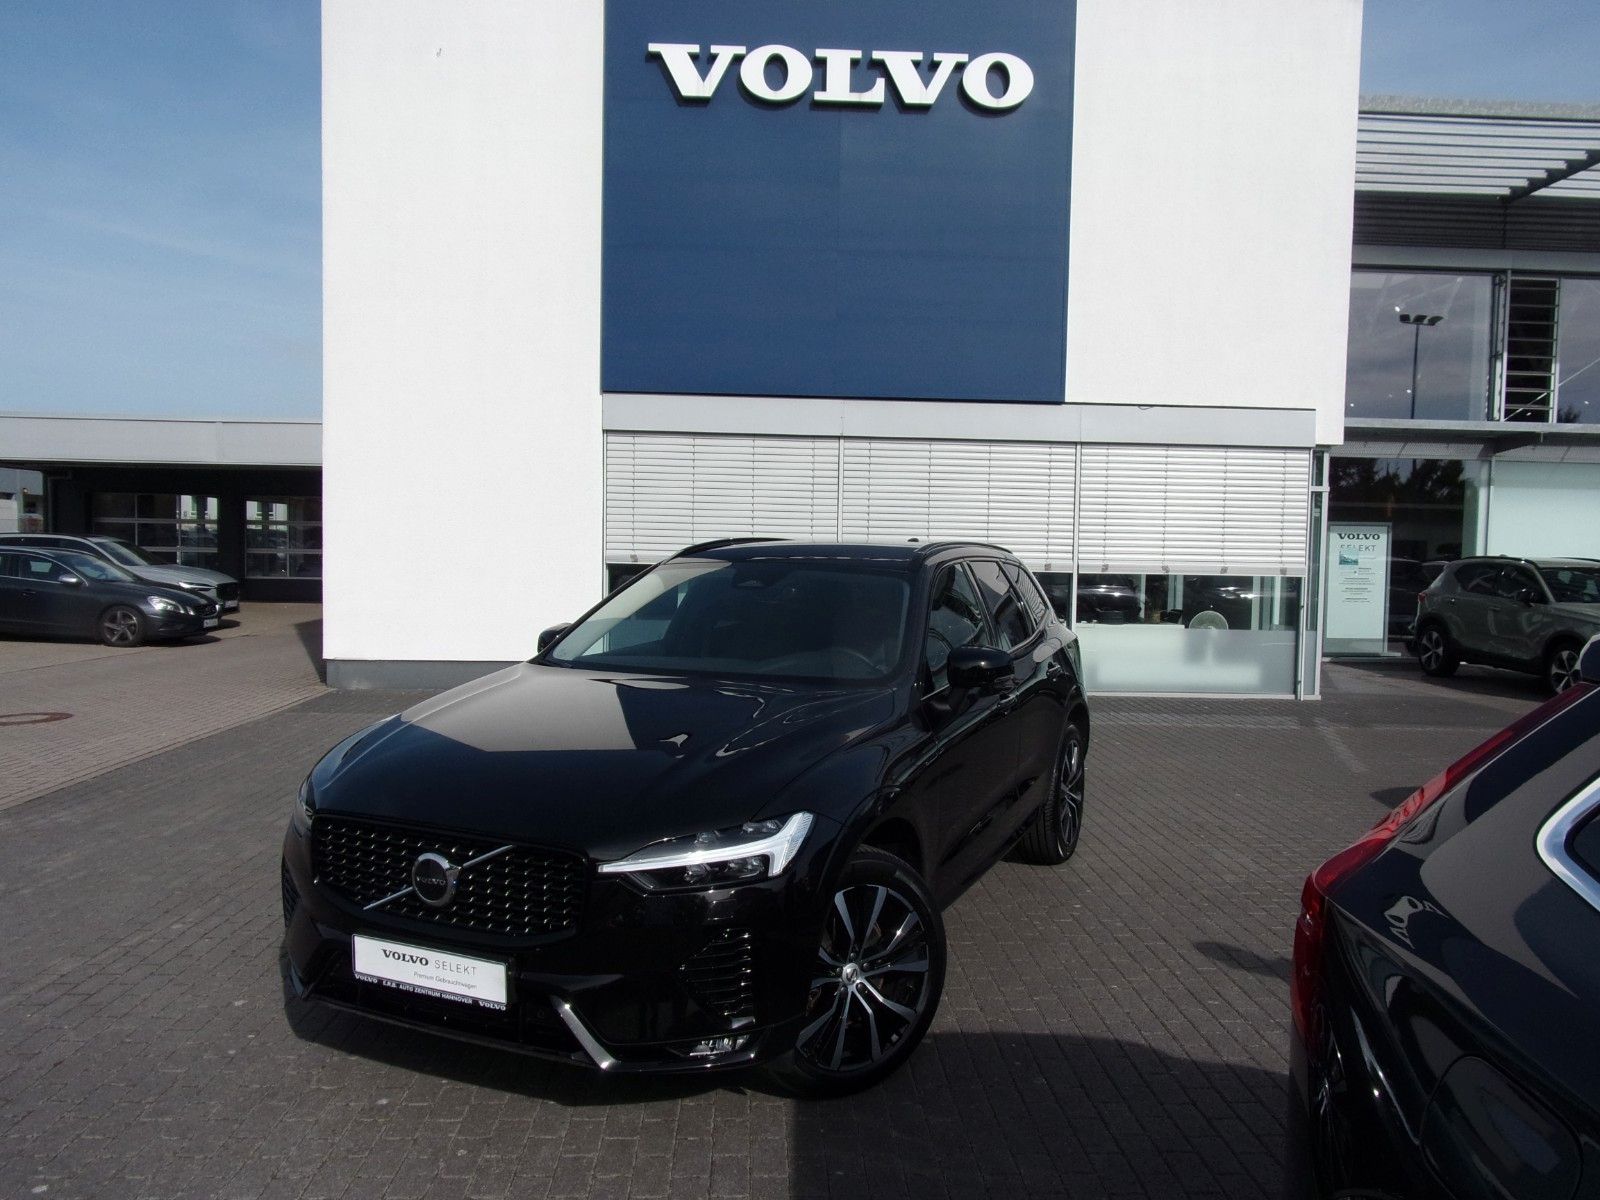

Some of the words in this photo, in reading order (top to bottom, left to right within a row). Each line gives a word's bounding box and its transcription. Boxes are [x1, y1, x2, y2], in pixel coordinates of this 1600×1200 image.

[648, 43, 1034, 108] VOLVO
[381, 949, 429, 966] VOLVO
[434, 959, 477, 976] SELEKT
[354, 973, 378, 984] VOLVO
[399, 984, 414, 993] AUTO
[414, 987, 441, 998] ZENTRUM
[441, 992, 473, 1004] HANNOVER
[479, 1000, 506, 1011] VOLVO
[413, 971, 434, 982] Premium
[435, 975, 478, 990] Gebrauchtwagen
